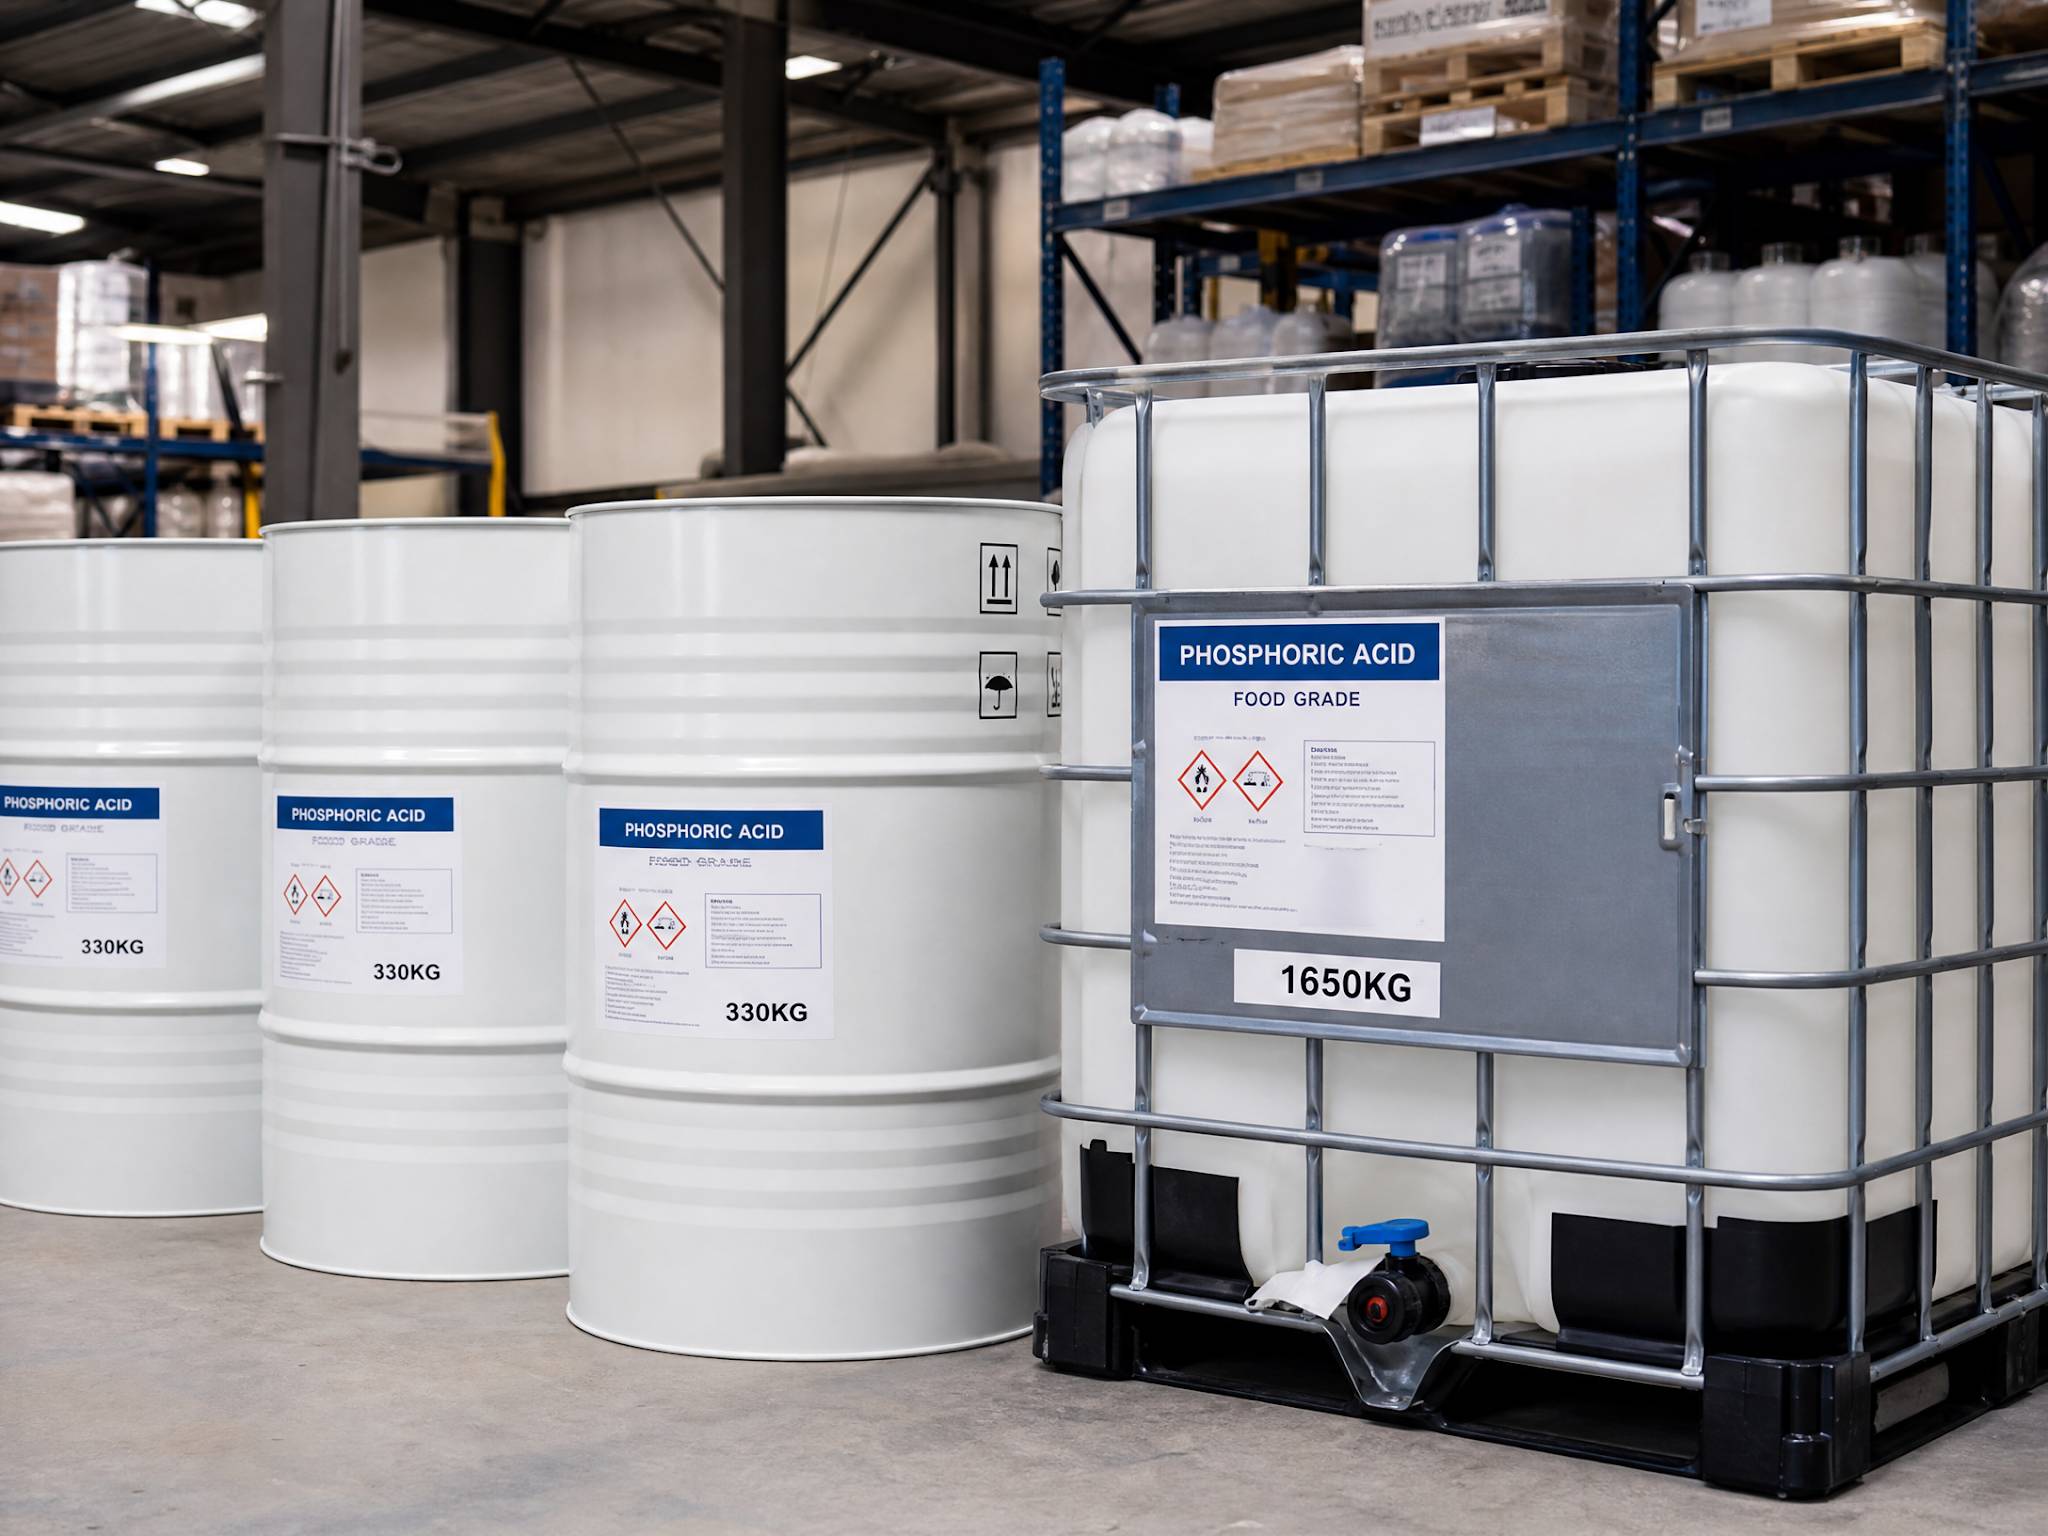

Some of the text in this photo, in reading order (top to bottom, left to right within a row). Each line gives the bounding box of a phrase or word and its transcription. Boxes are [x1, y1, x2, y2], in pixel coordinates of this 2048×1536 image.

[1180, 642, 1416, 666] PHOSPHORIC ACID
[1234, 691, 1361, 707] FOOD GRADE
[4, 795, 133, 812] PHOSPHORIC ACID
[292, 807, 426, 823] PHOSPHORIC ACID
[625, 822, 784, 840] PHOSPHORIC ACID
[81, 938, 144, 955] 330KG
[373, 963, 441, 981] 330KG
[1281, 964, 1412, 1003] 1650KG
[725, 1002, 808, 1022] 330KG
